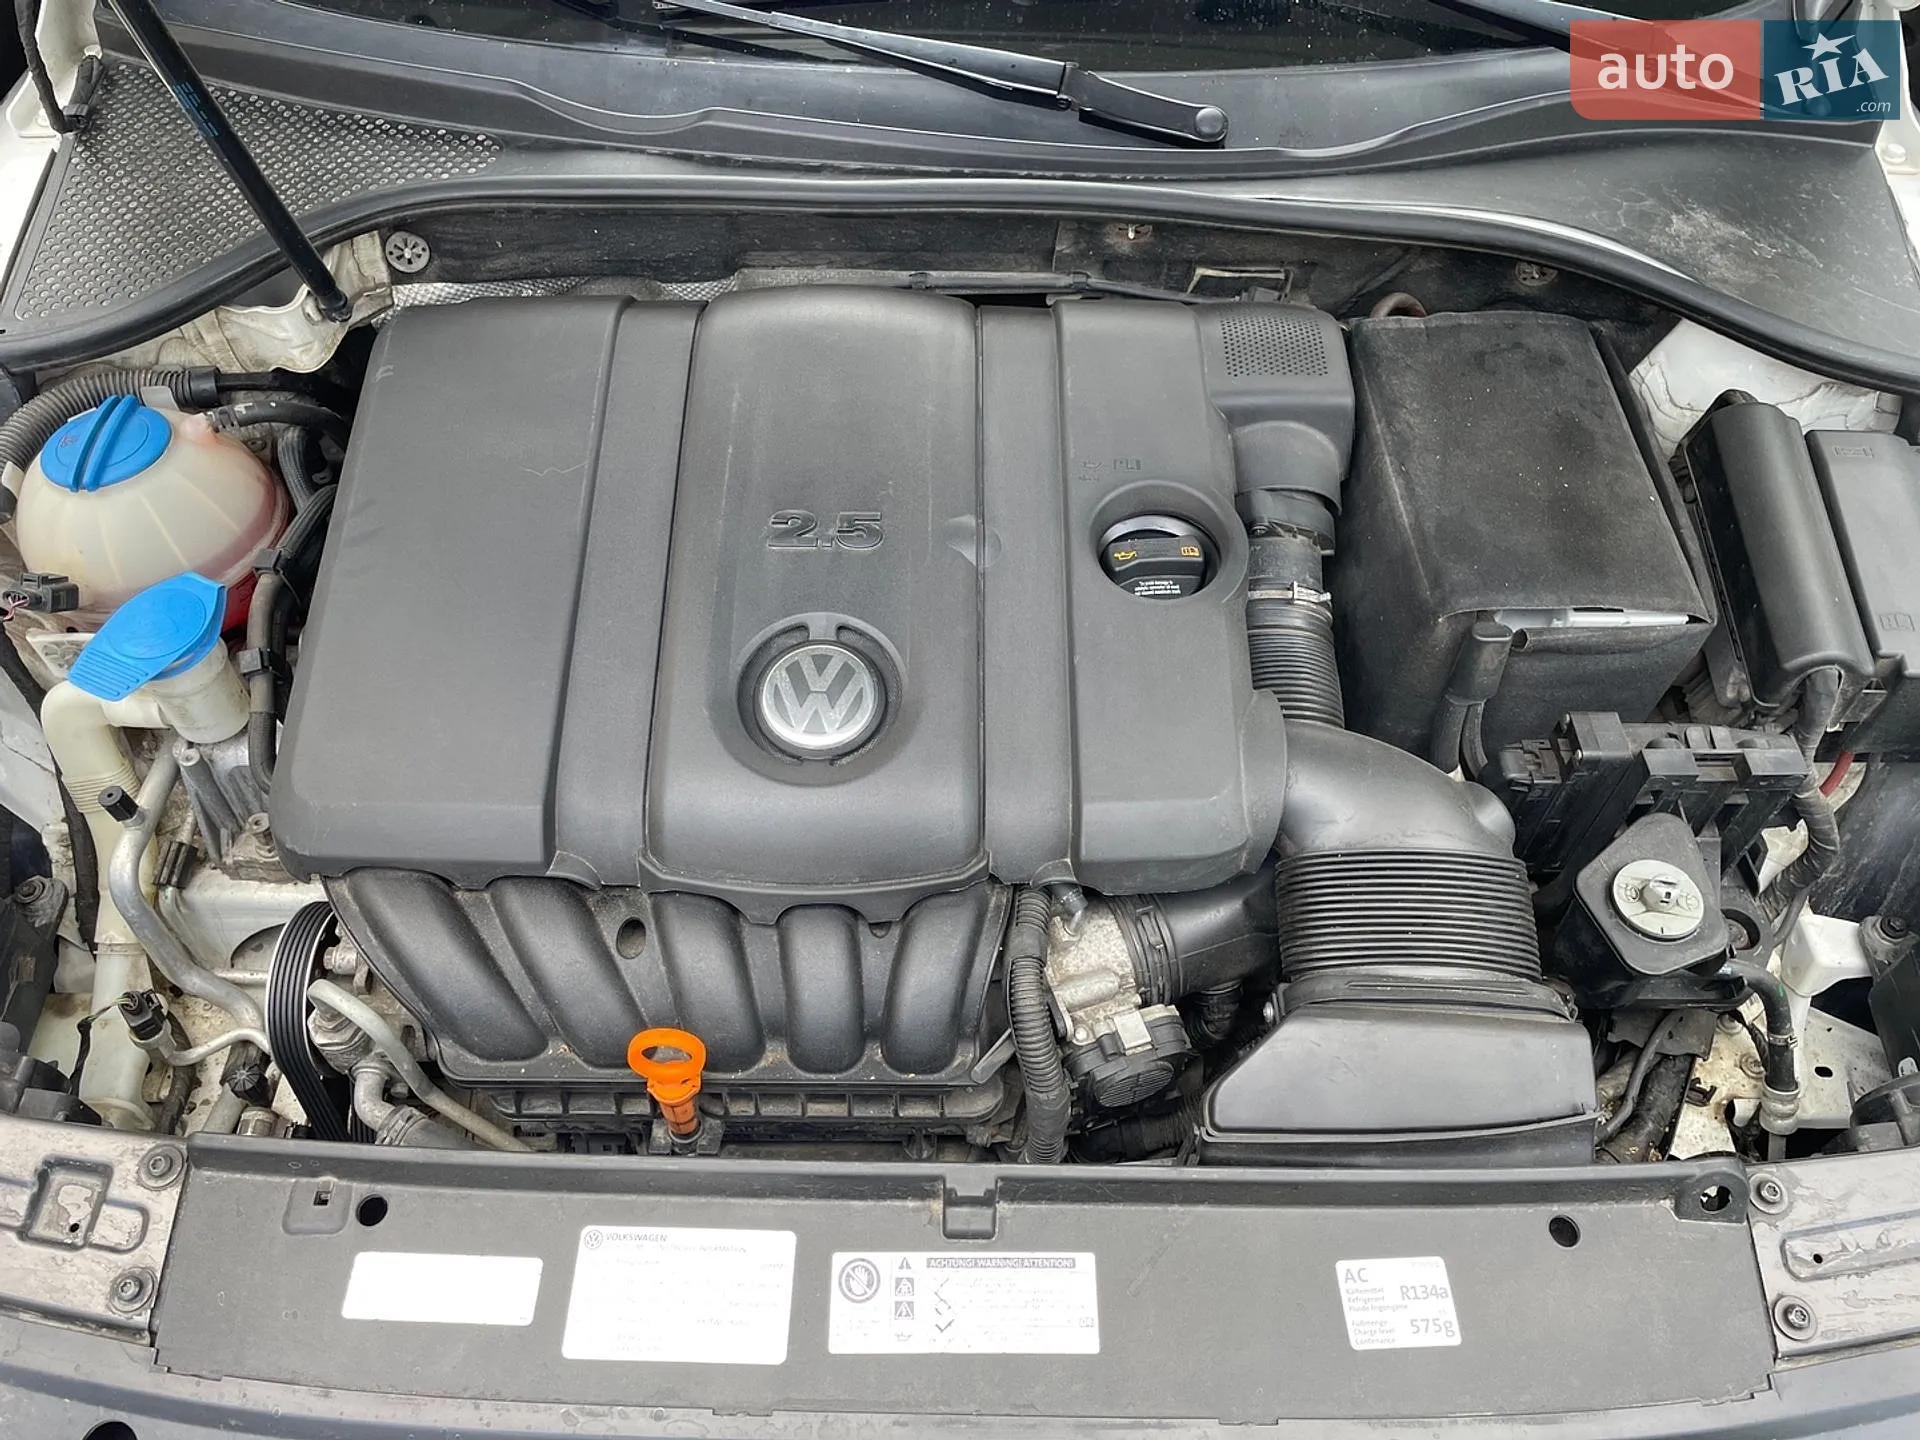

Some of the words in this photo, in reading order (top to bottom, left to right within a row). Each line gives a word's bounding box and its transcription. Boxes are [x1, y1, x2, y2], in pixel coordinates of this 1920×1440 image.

[767, 509, 884, 550] 2.5
[606, 1232, 668, 1242] VOLKSWAGEN
[930, 1258, 976, 1268] ACHTUNG!
[977, 1258, 1022, 1268] WARNING!
[1023, 1258, 1074, 1268] ATTENTION!
[1344, 1267, 1369, 1284] AC
[1400, 1284, 1449, 1301] R134a
[1410, 1317, 1456, 1338] 575g
